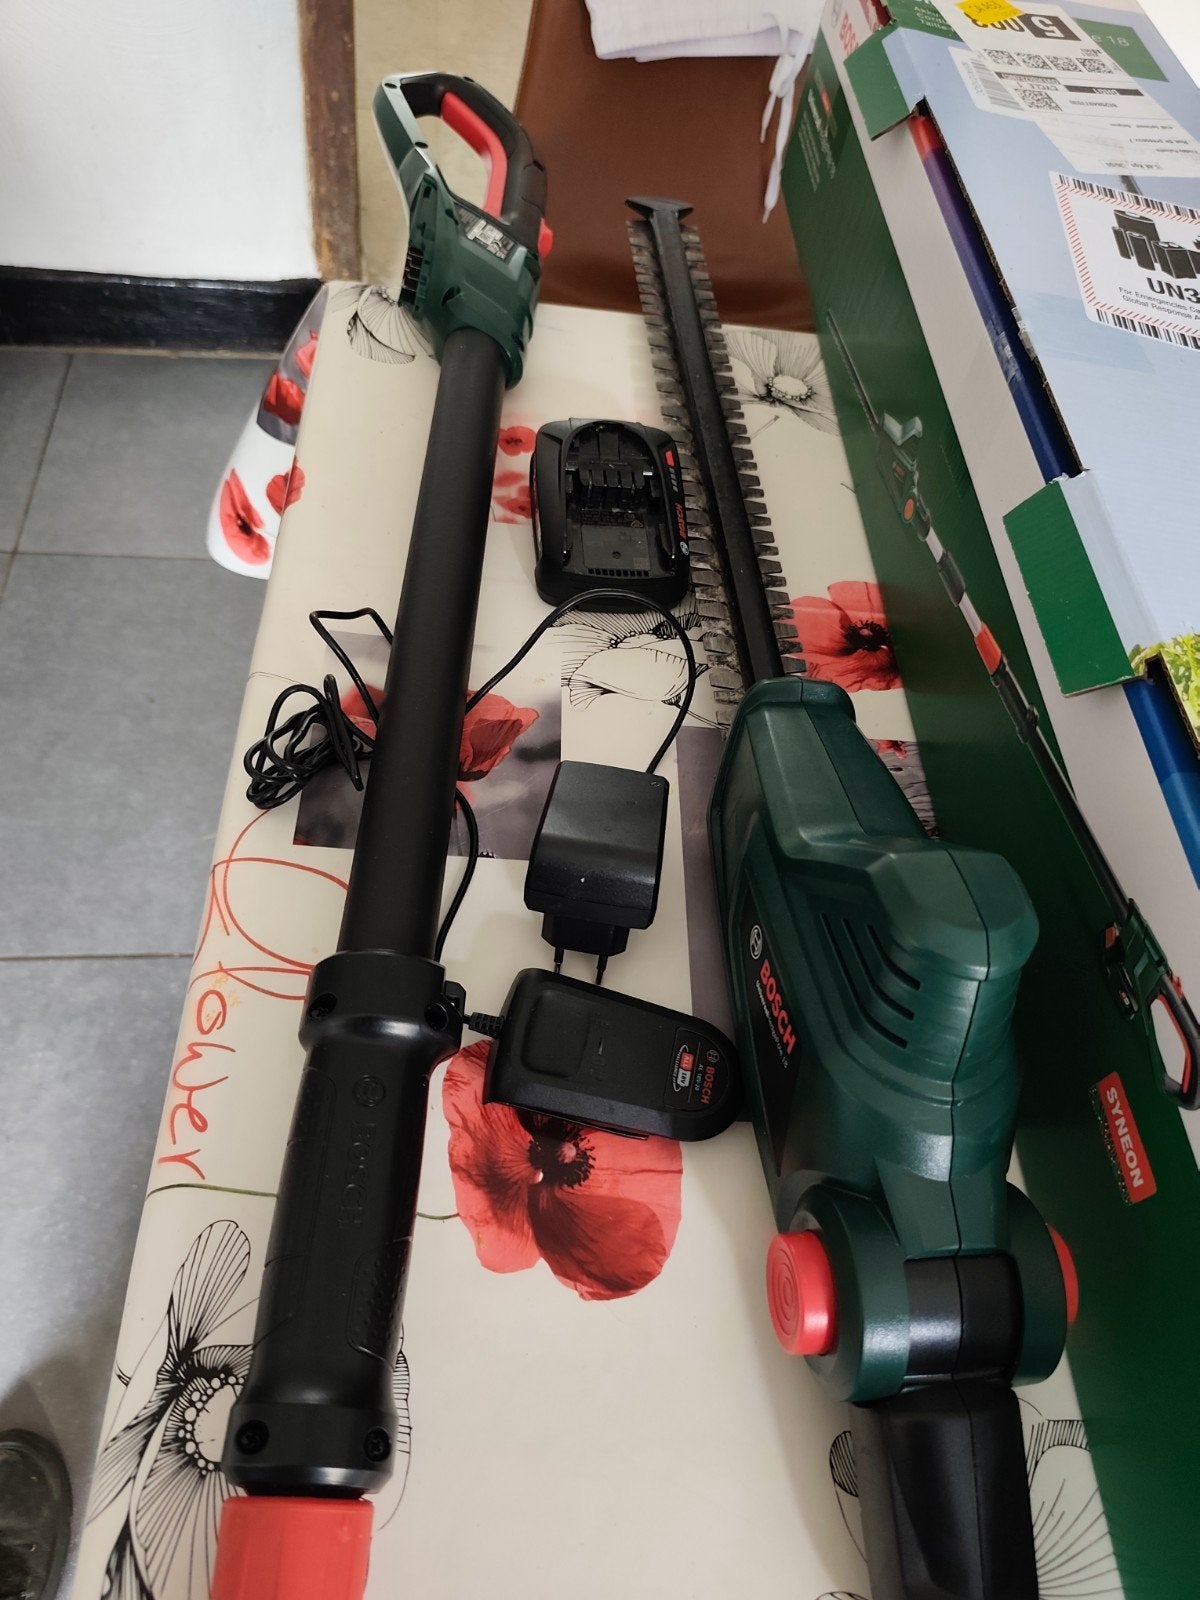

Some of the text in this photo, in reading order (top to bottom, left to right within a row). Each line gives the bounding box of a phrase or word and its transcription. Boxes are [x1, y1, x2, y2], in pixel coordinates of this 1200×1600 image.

[760, 959, 796, 1054] BOSCH
[700, 1066, 715, 1104] BOSCH
[337, 1121, 376, 1229] BOSCH
[1106, 1087, 1144, 1188] SYNEON
